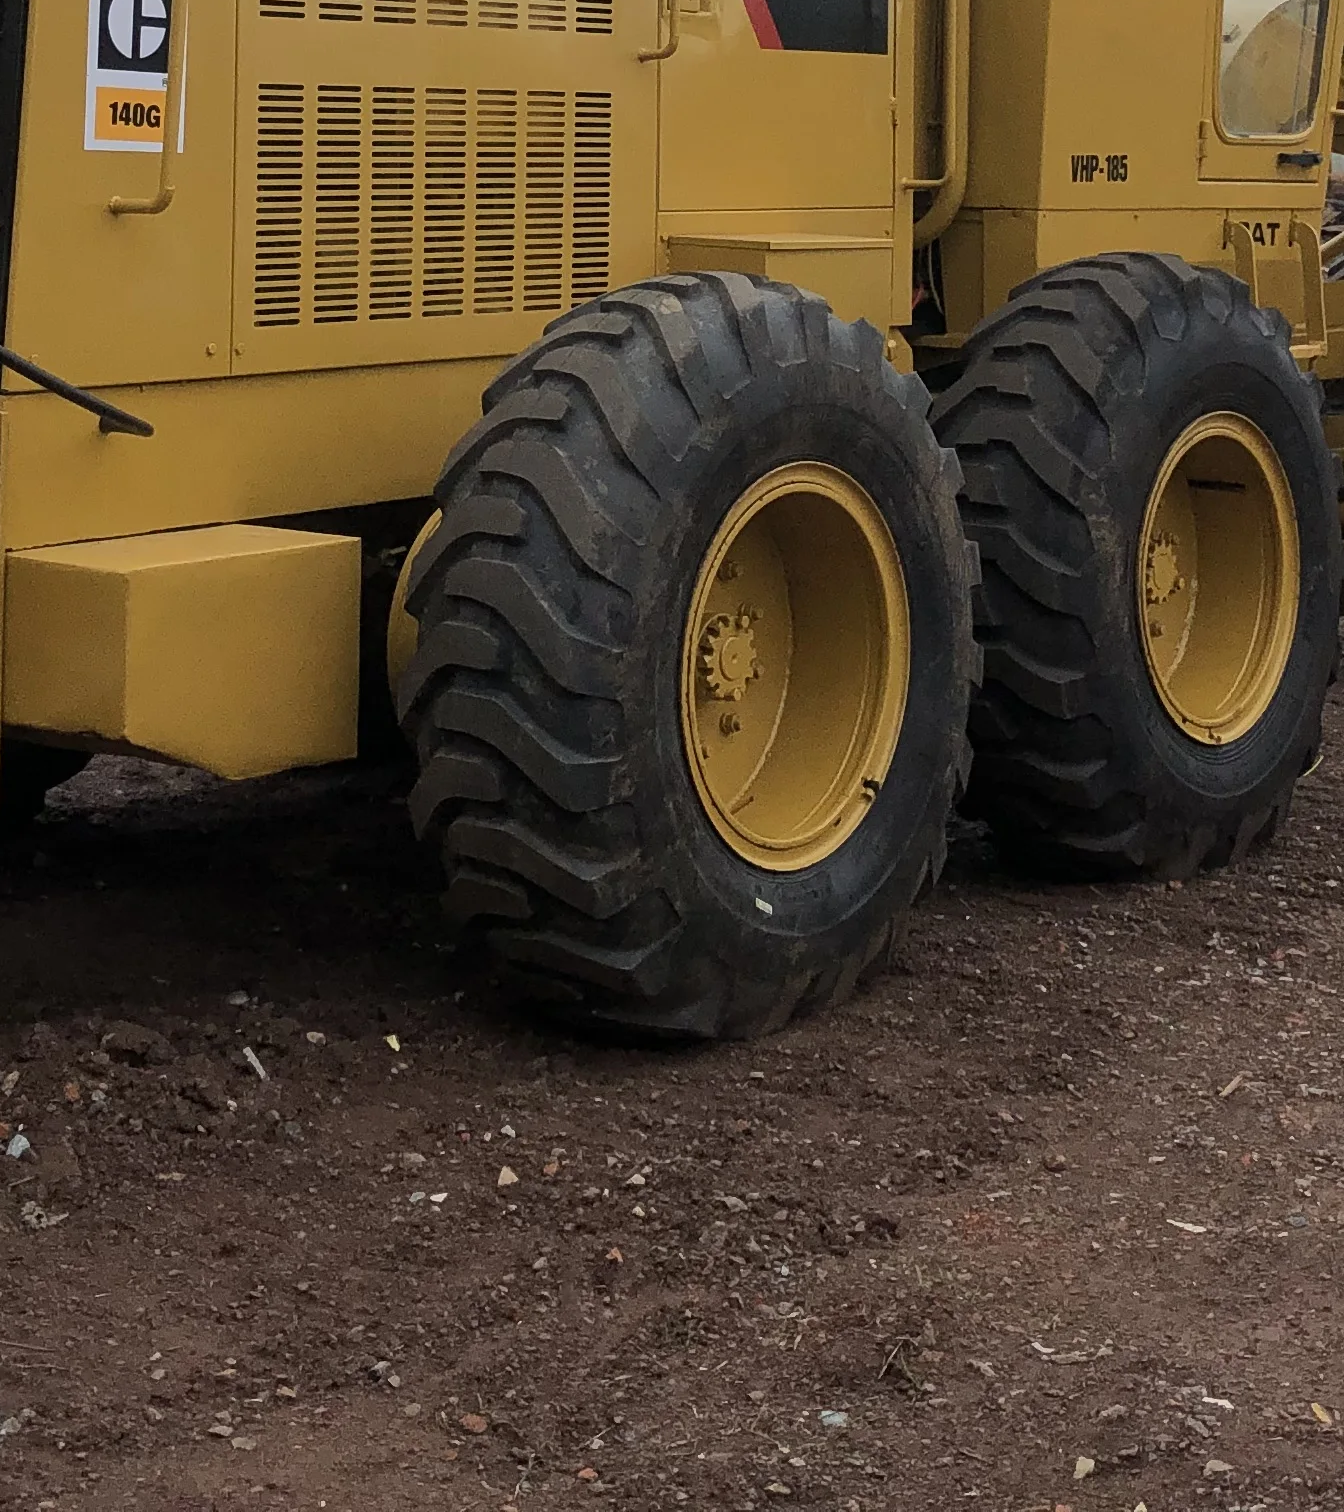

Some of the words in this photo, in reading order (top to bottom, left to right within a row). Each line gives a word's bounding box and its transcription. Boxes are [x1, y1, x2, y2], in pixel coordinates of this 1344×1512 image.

[109, 101, 161, 128] 140G
[1071, 154, 1128, 182] VHP-185
[1239, 222, 1281, 246] AT
